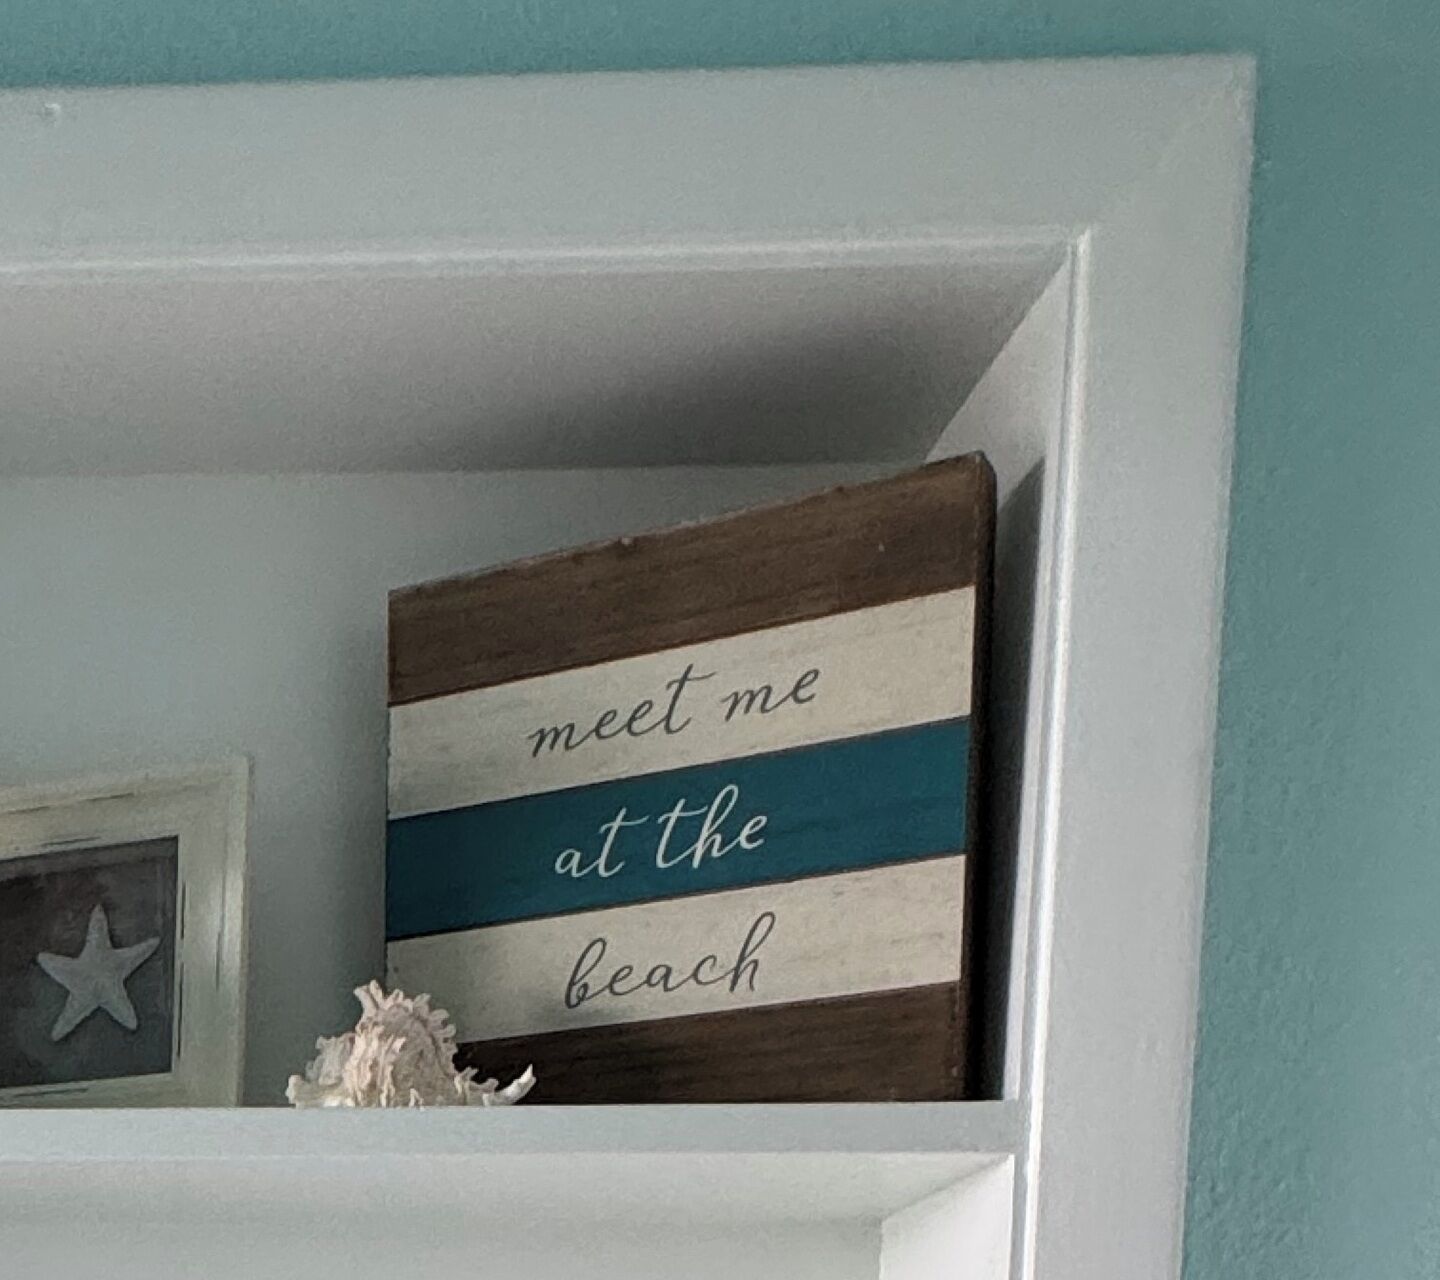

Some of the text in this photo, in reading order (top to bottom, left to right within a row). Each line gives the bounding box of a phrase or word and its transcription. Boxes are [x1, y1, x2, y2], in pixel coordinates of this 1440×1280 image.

[526, 662, 821, 758] meet me
[554, 783, 769, 879] at the
[562, 910, 778, 1010] beach
